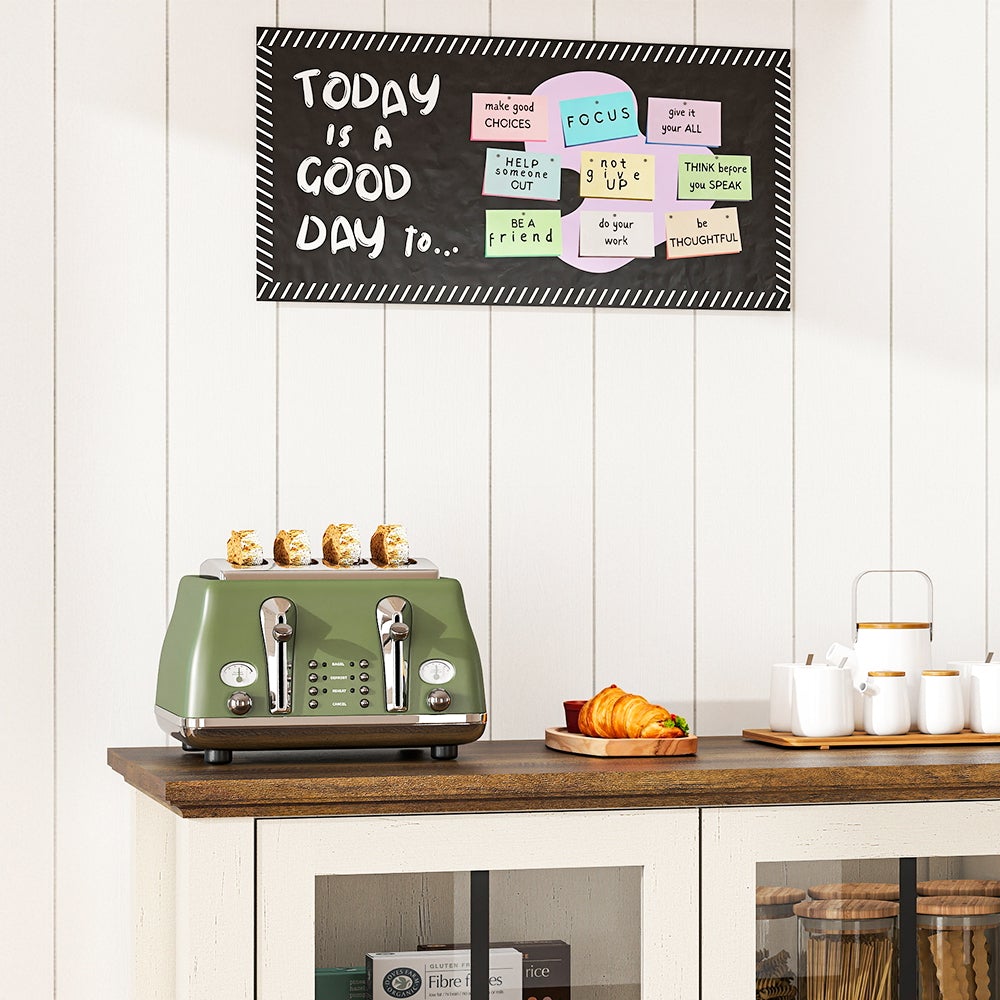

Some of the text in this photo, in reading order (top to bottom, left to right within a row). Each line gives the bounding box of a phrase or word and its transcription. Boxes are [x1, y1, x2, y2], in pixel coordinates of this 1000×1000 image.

[293, 68, 440, 119] TODAY
[485, 100, 534, 115] make good
[668, 107, 696, 118] give it
[484, 118, 531, 129] CHOICES
[567, 107, 631, 128] FOCUS
[661, 123, 702, 135] your ALL
[326, 123, 393, 151] IS A
[505, 157, 539, 169] HELP
[600, 157, 627, 168] not
[684, 161, 748, 176] THINK before
[297, 156, 412, 202] GOOD
[495, 168, 548, 179] someone
[586, 165, 641, 183] give
[606, 178, 629, 191] UP
[689, 179, 742, 192] you SPEAK
[511, 218, 536, 228] BE A
[598, 218, 634, 232] do your
[696, 218, 708, 229] be
[296, 214, 386, 259] DAY
[488, 228, 553, 247] friend
[604, 235, 629, 246] work
[669, 234, 739, 248] THOUGHTFUL
[525, 964, 550, 978] rice
[428, 974, 462, 989] Fibre
